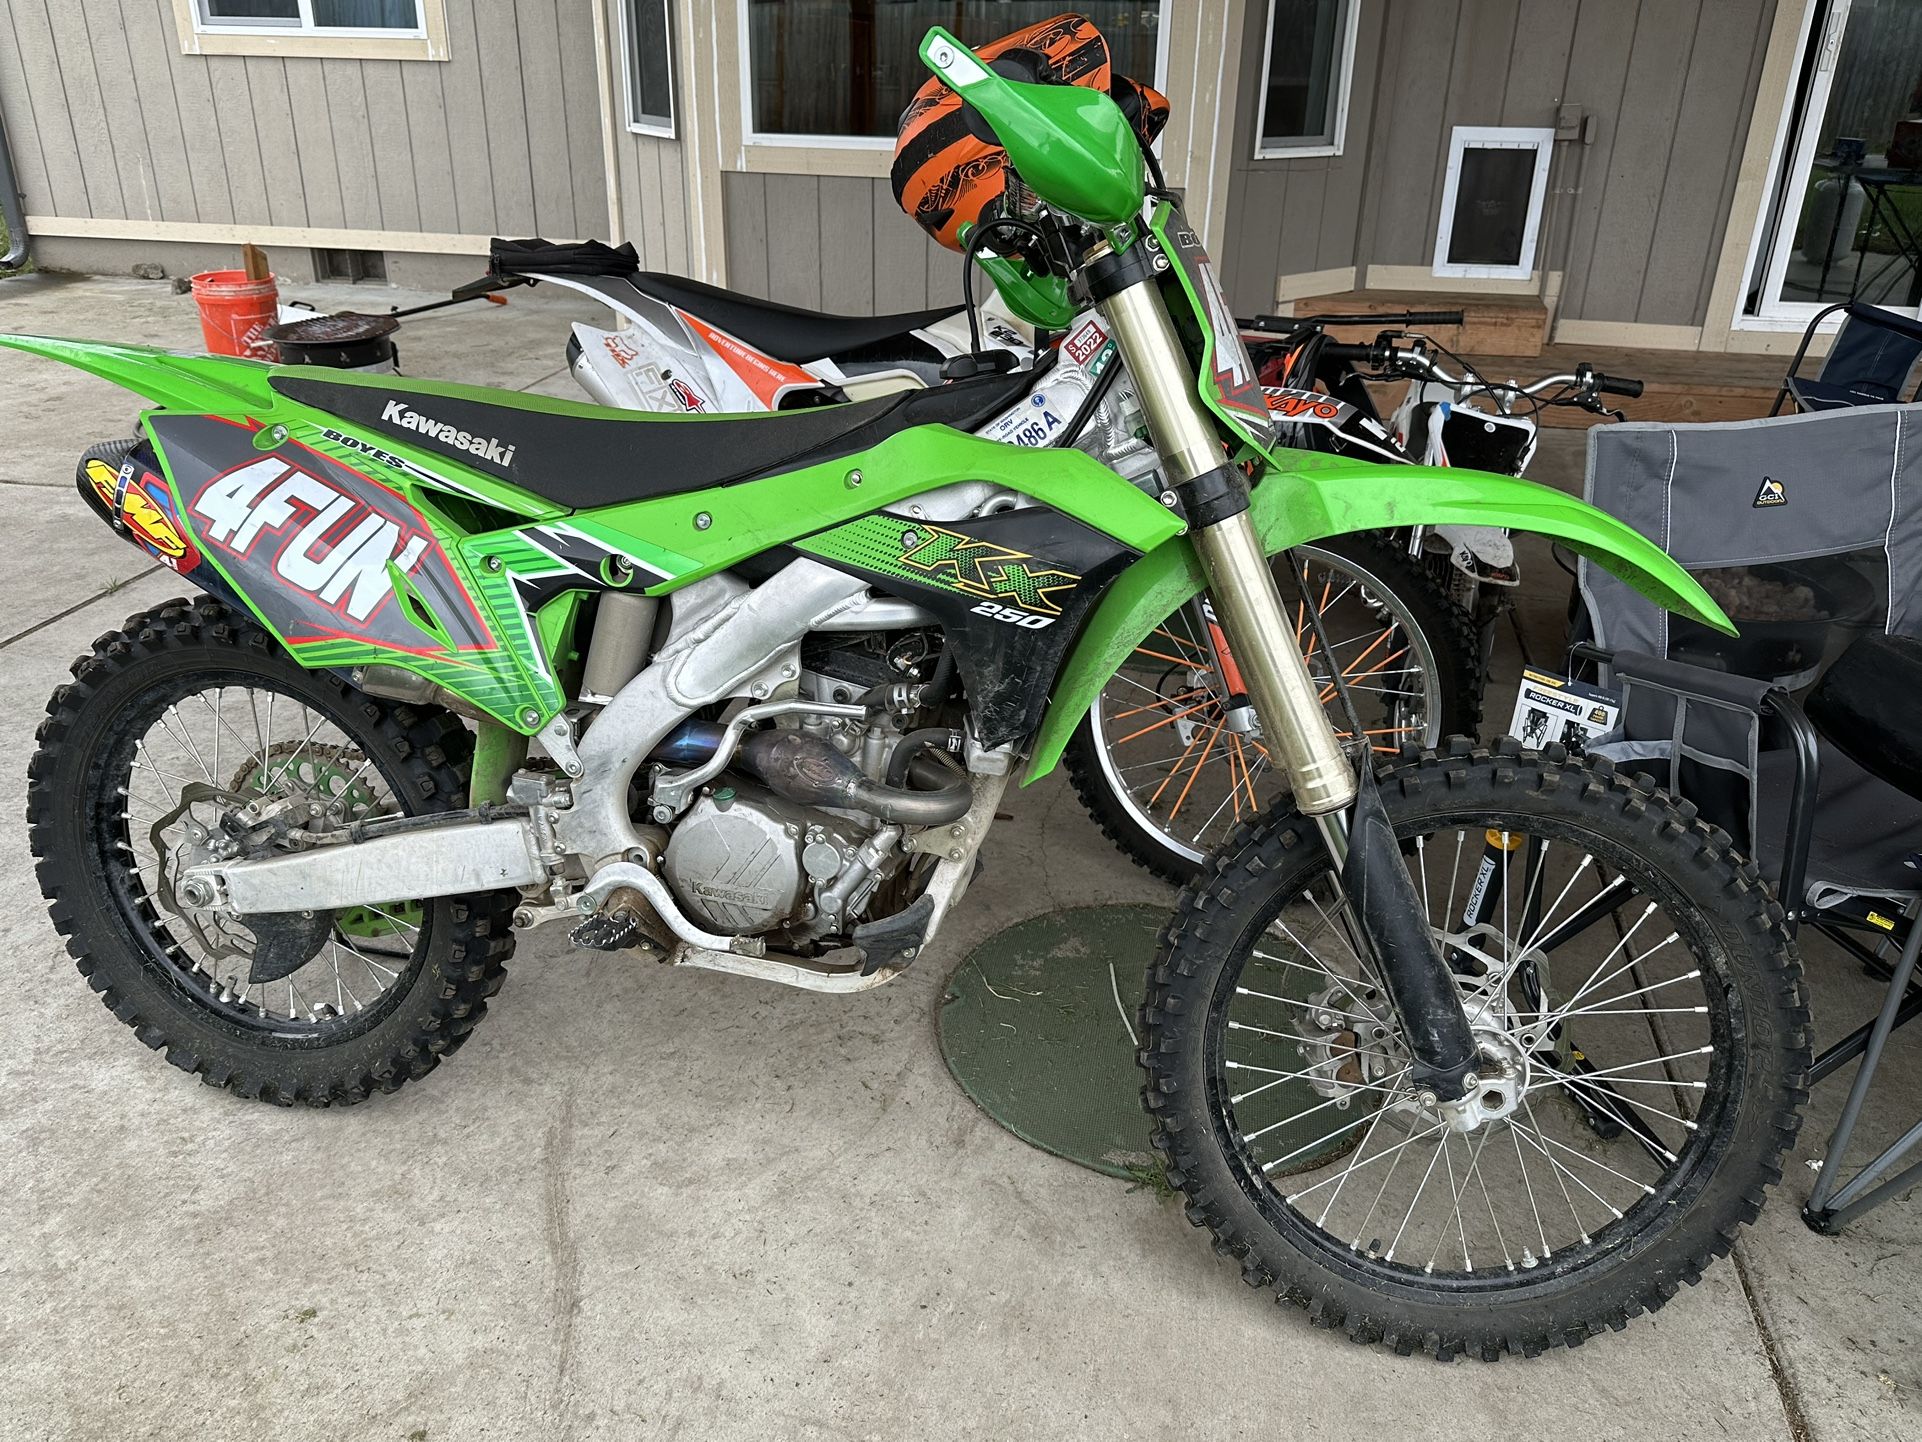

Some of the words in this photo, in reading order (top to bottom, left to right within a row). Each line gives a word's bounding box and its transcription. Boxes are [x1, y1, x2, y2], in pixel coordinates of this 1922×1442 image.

[708, 332, 747, 359] ADVENTURE
[745, 353, 770, 374] BEGINS
[768, 368, 786, 382] HERE
[1075, 332, 1103, 362] 2022
[381, 400, 516, 467] Kawasaki
[999, 418, 1013, 432] ORV
[1007, 421, 1047, 447] 486
[1042, 410, 1062, 431] A
[322, 429, 405, 468] BOYES
[1759, 493, 1779, 501] GCI
[194, 455, 430, 623] 4FUN
[898, 524, 1082, 616] KX
[970, 601, 1056, 629] 250
[1529, 692, 1565, 709] ROCKER
[1564, 703, 1576, 713] XL
[1533, 685, 1580, 704] FREESTYLE
[691, 881, 769, 905] Kawasaki
[1466, 878, 1485, 919] ROCKER
[1480, 866, 1490, 879] XL
